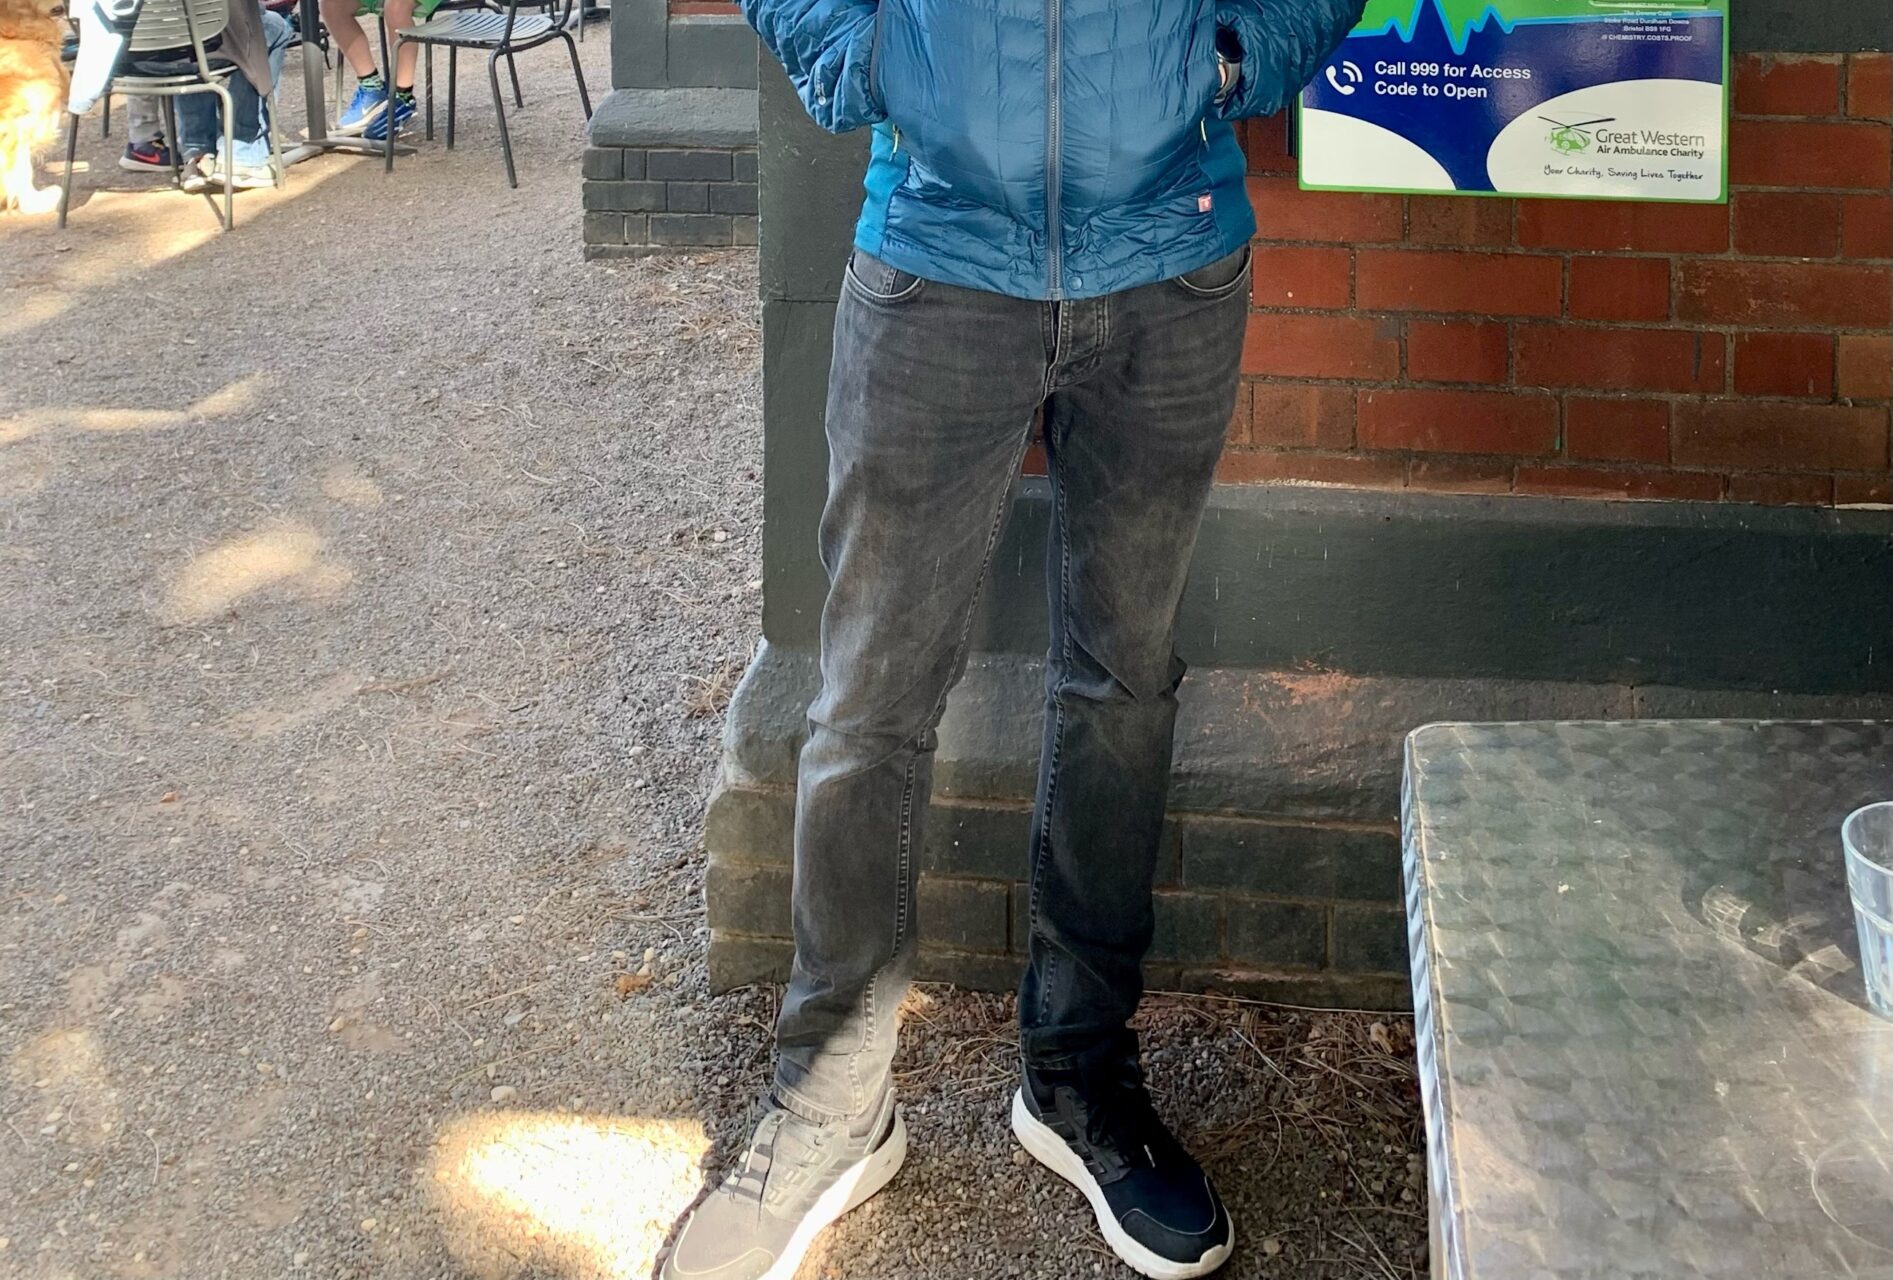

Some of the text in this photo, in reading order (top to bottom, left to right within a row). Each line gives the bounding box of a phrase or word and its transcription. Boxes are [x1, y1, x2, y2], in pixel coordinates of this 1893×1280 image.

[1374, 60, 1532, 79] Call 999 for Access
[1374, 81, 1488, 100] Code to Open
[1595, 129, 1705, 147] Great Western
[1596, 146, 1704, 159] Air Ambulance Charity
[1544, 164, 1564, 176] Your
[1608, 168, 1638, 180] Saving
[1640, 169, 1664, 179] Lives
[1667, 169, 1703, 182] Together
